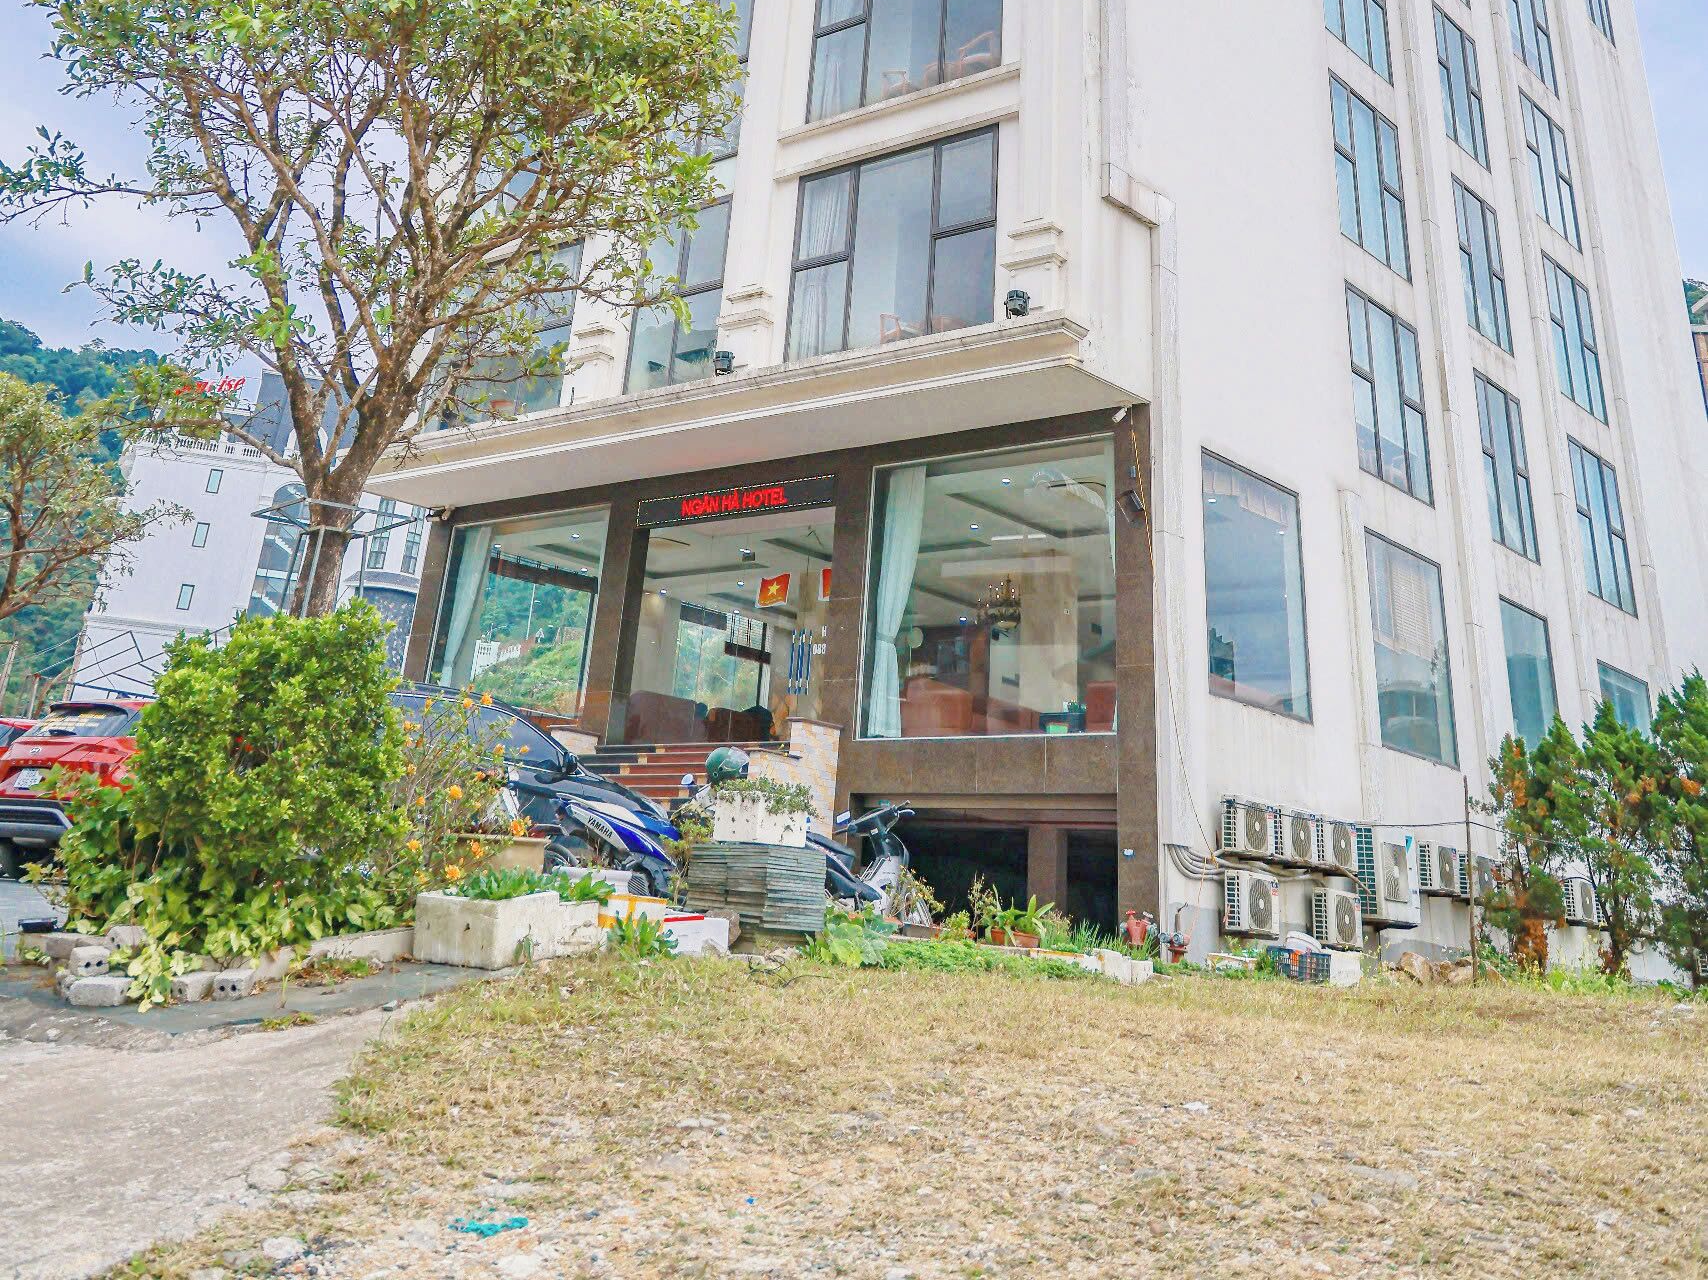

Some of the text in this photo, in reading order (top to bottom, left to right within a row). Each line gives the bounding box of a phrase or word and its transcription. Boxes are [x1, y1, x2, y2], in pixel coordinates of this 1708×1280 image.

[681, 492, 719, 517] NGÂN
[742, 486, 788, 509] HOTEL
[587, 815, 613, 839] YAMAHA
